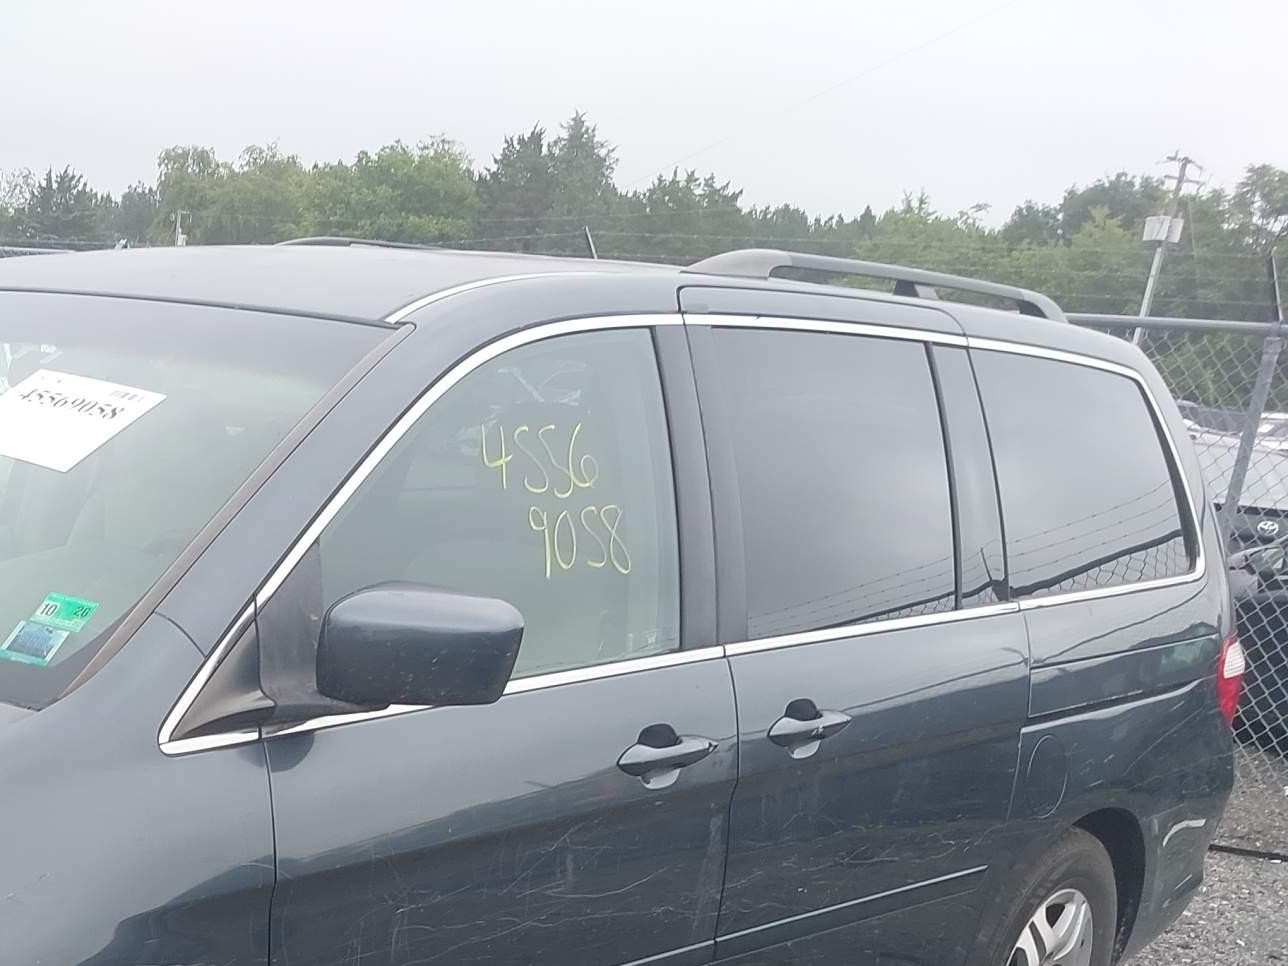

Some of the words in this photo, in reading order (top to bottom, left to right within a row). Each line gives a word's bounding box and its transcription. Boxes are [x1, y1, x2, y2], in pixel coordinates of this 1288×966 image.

[19, 388, 125, 419] 45569058
[481, 423, 599, 498] 4556
[528, 504, 632, 579] 9058
[39, 602, 58, 617] 10
